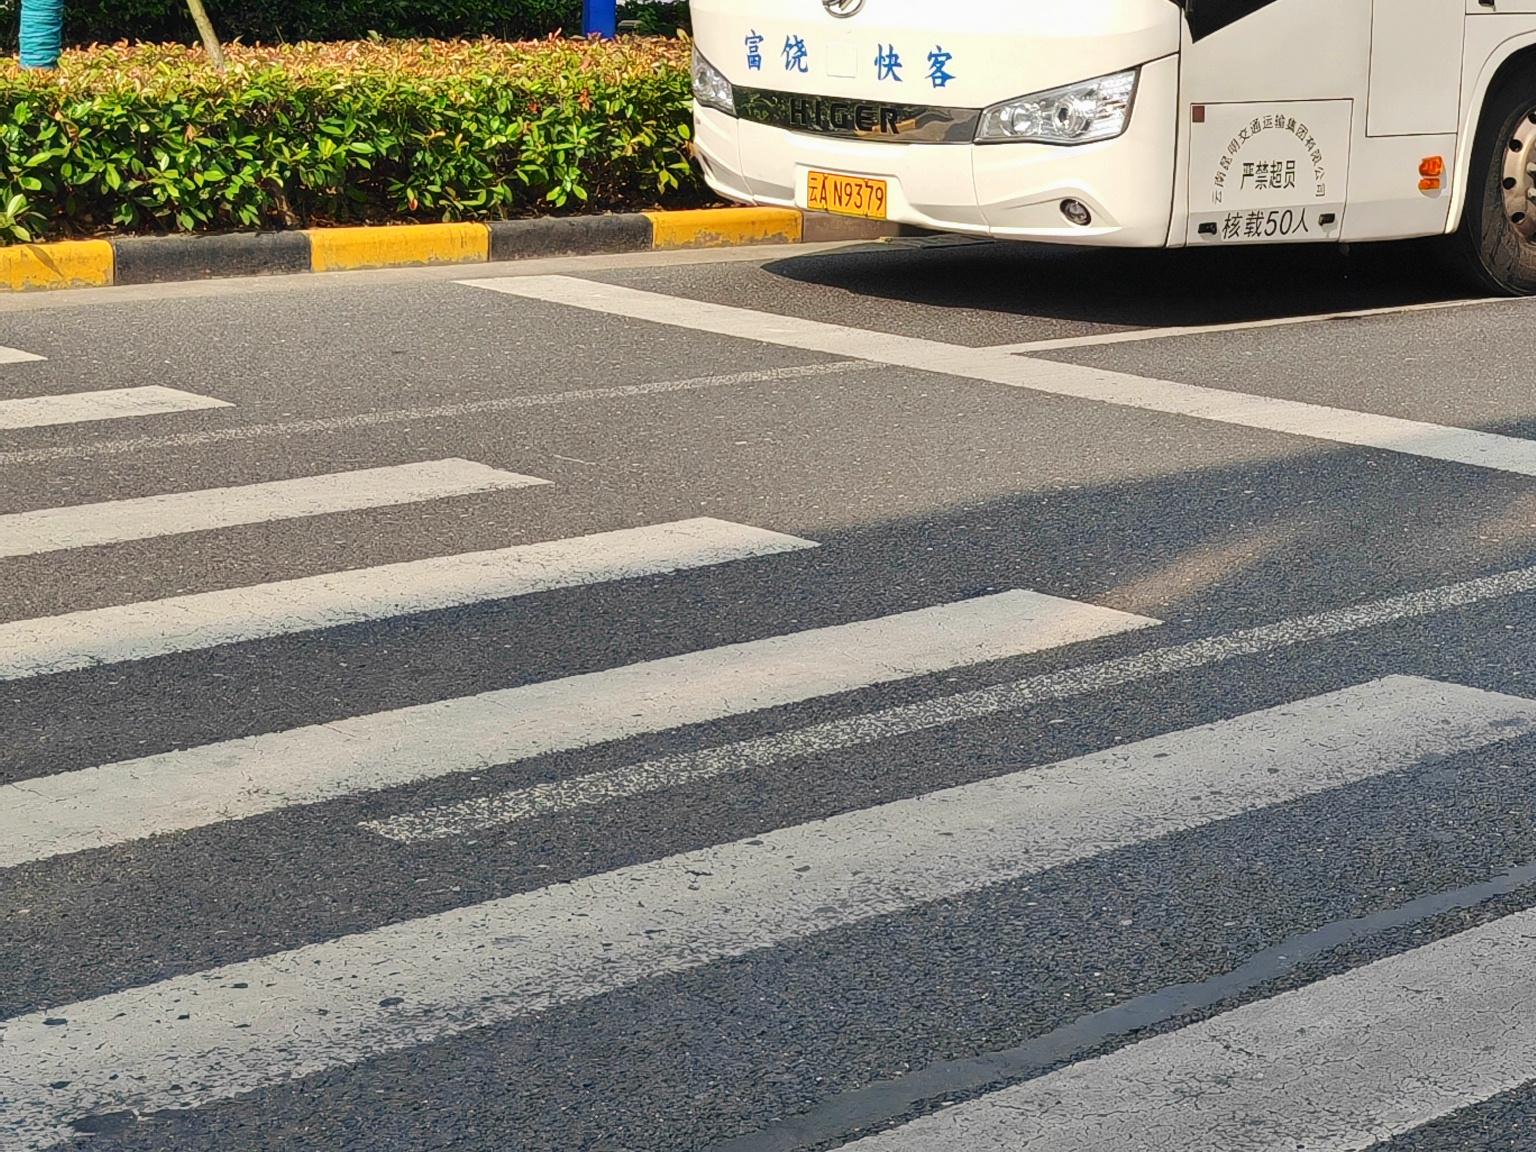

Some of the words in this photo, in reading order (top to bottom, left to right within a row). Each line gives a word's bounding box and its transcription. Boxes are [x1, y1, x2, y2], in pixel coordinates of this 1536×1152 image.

[873, 43, 957, 89] 快客
[789, 97, 900, 135] HIGER
[1211, 113, 1326, 205] 云南昆明交通运输集团有限公司
[1240, 160, 1296, 190] 严禁超员
[1221, 207, 1309, 239] 核载50人
